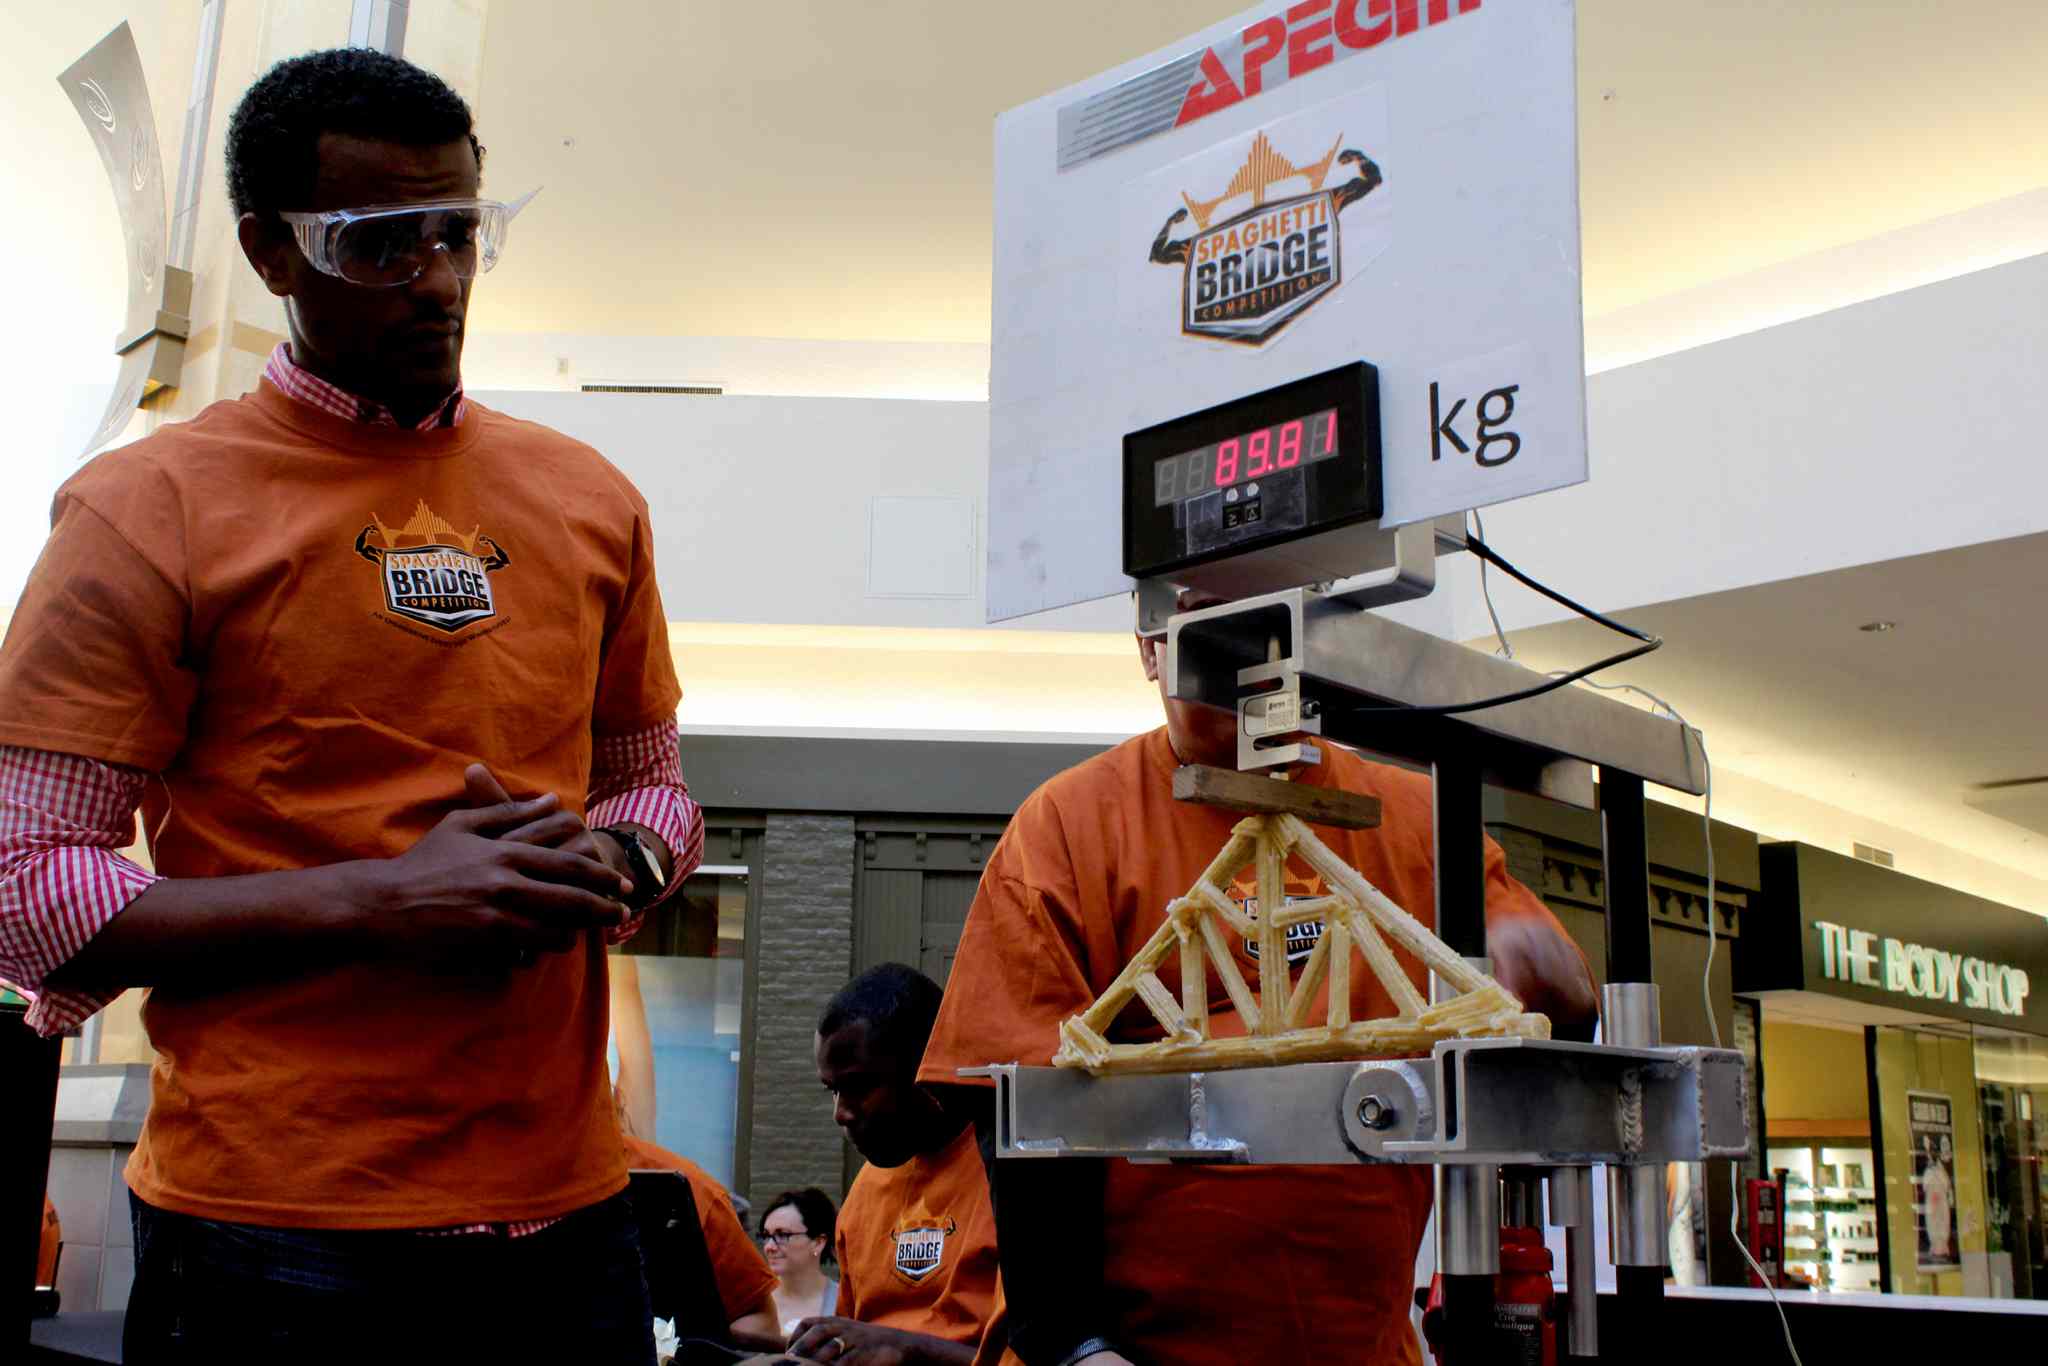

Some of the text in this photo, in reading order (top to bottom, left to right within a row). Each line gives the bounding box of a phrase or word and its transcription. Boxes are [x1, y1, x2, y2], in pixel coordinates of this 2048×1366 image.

[1197, 197, 1327, 263] SPAGHETTI
[1197, 224, 1328, 305] BRIDGE
[1202, 271, 1321, 319] COMPETITION
[1215, 410, 1337, 486] 89.81
[1429, 382, 1521, 467] kg
[389, 552, 481, 574] SPAGHETTI
[391, 569, 488, 600] BRIDGE
[402, 597, 485, 608] COMPETITION
[1813, 921, 2030, 1015] THE BODY SHOP
[899, 1242, 940, 1259] BRIDGE
